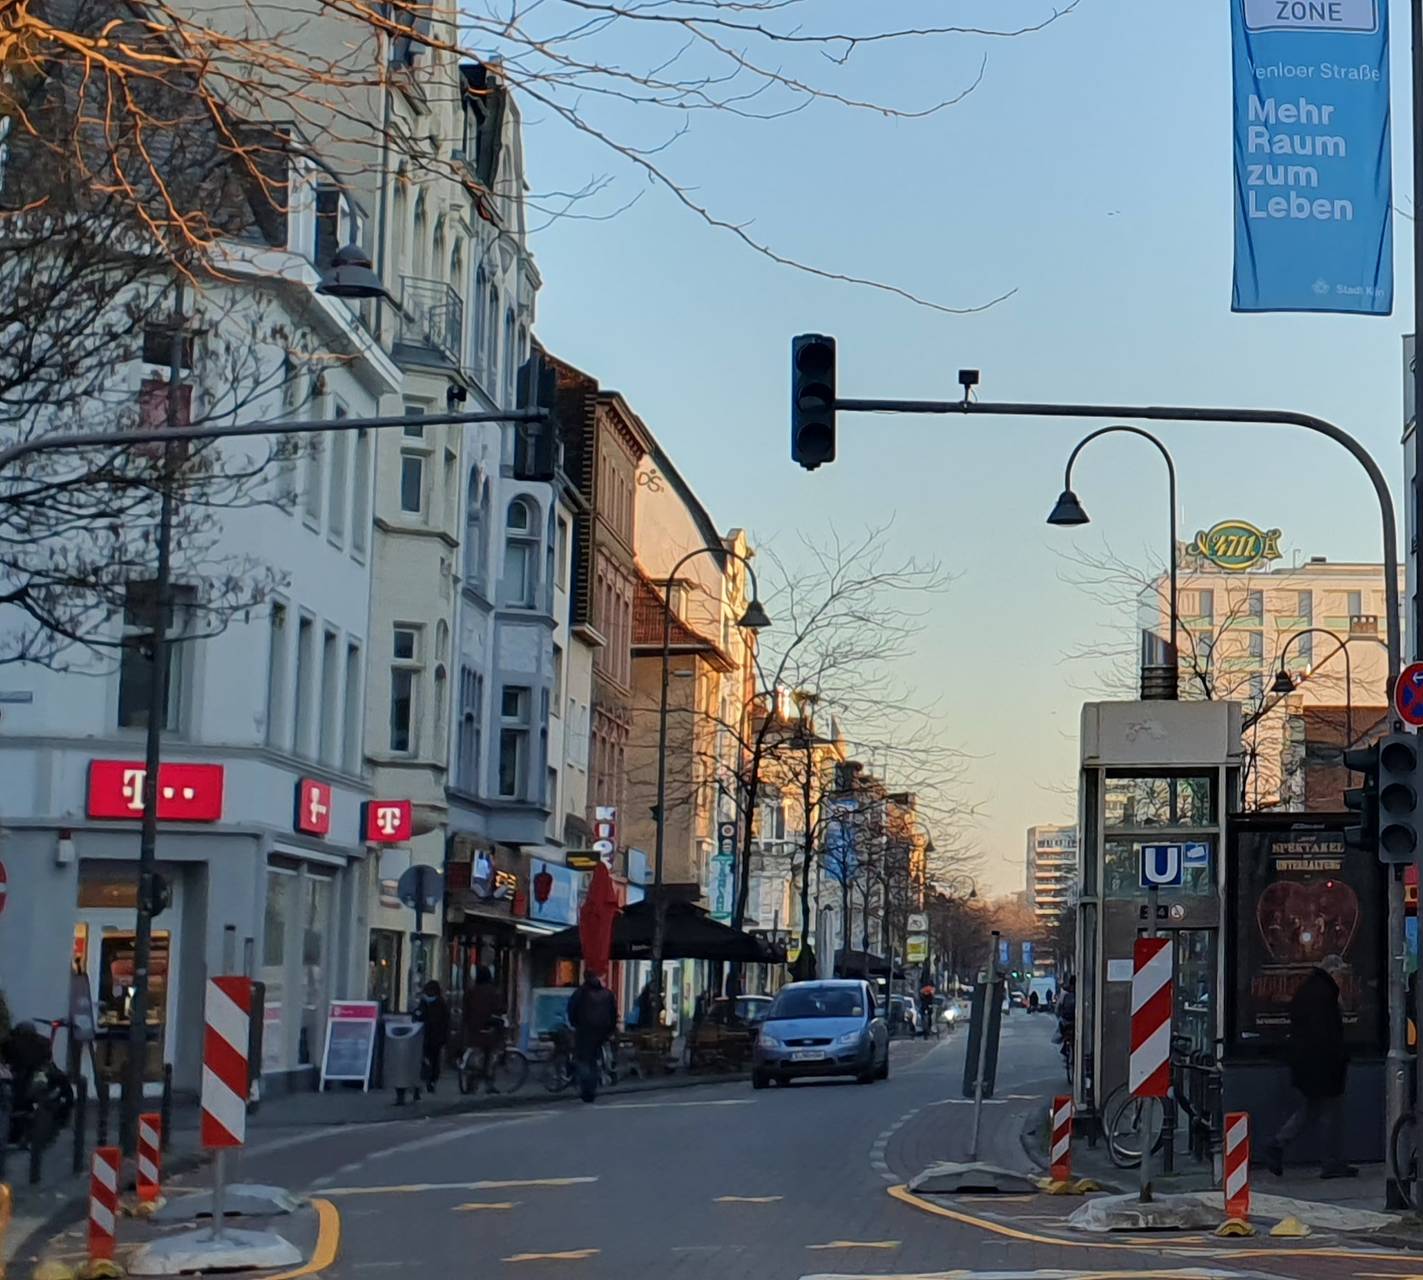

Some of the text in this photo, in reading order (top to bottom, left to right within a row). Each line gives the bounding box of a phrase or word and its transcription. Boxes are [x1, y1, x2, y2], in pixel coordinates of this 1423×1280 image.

[1276, 1, 1343, 21] ZONE
[1320, 63, 1380, 81] Straße
[1248, 94, 1334, 125] Mehr
[1248, 126, 1346, 157] Raum
[1247, 164, 1318, 187] zum
[1248, 190, 1353, 221] Leben
[377, 807, 401, 834] T
[1144, 847, 1179, 884] U
